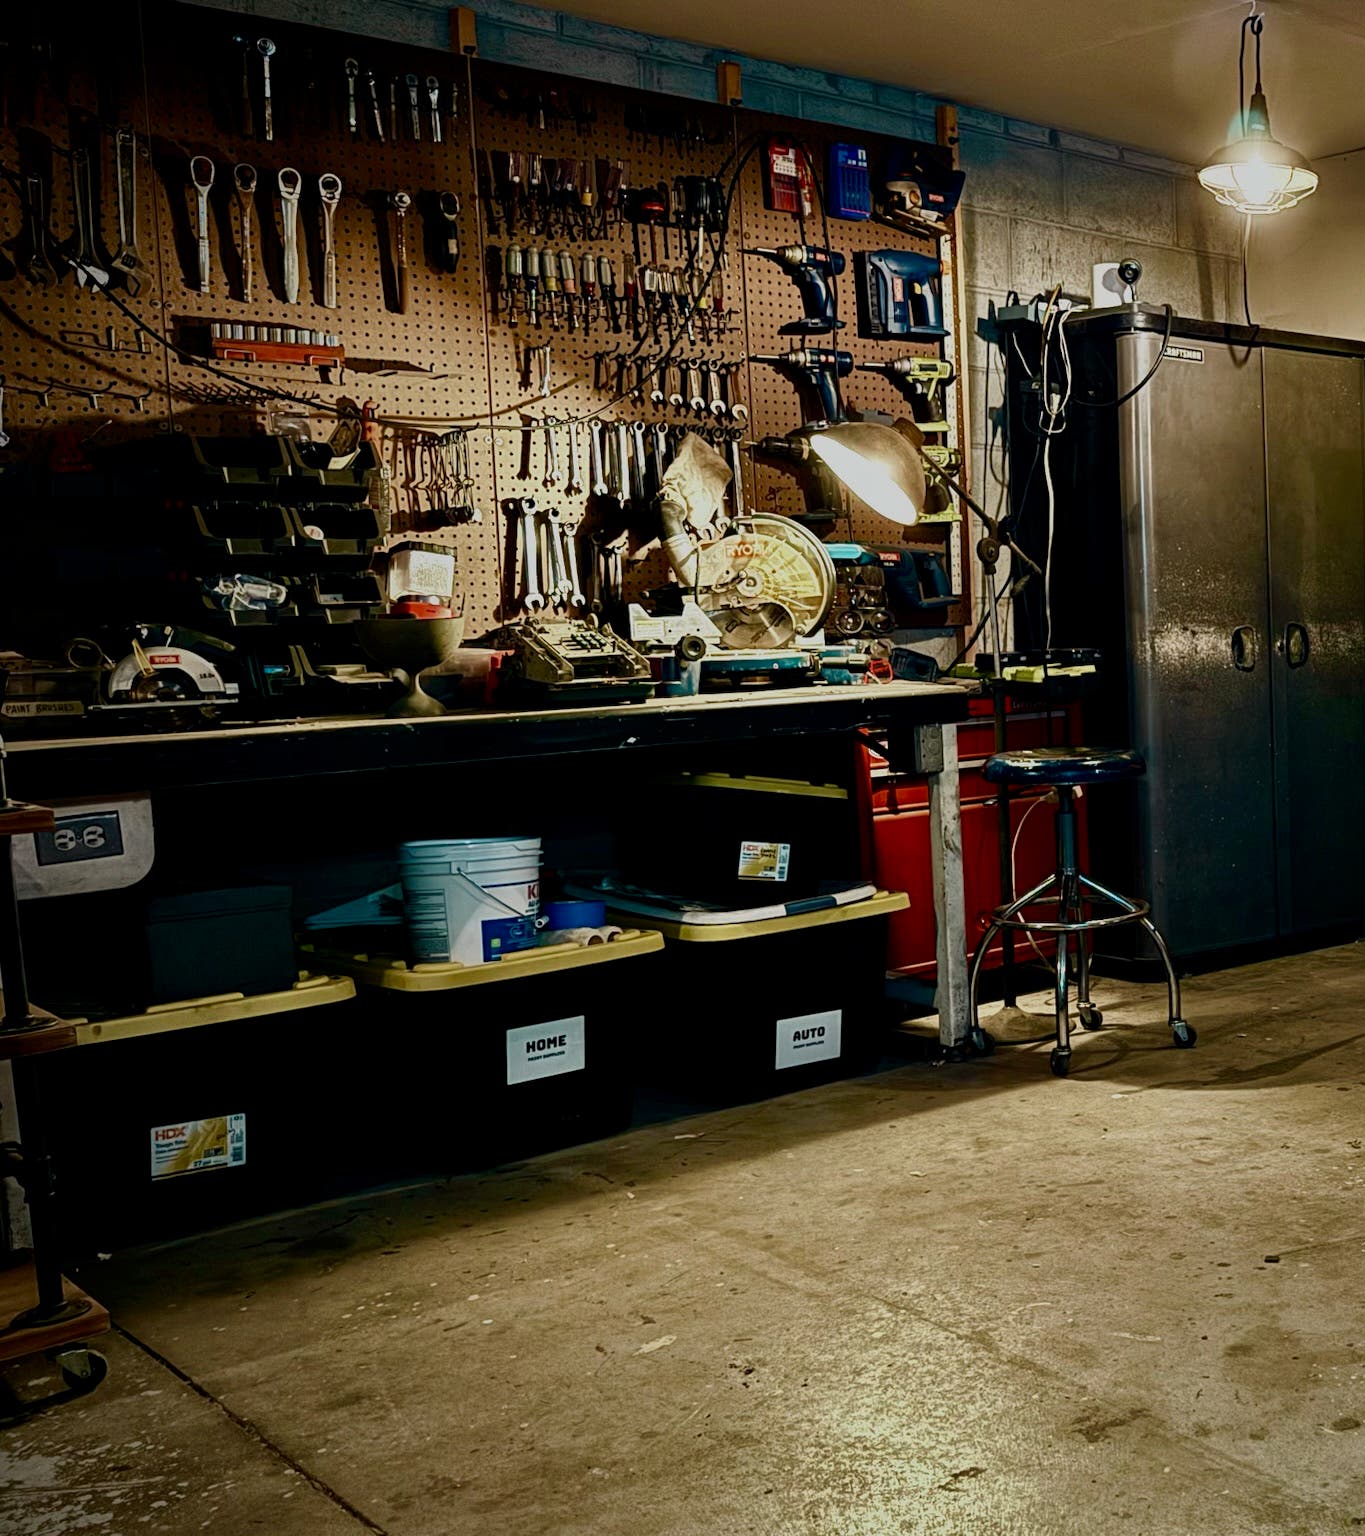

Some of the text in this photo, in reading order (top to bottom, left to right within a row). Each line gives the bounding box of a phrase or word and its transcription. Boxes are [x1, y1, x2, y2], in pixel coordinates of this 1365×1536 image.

[6, 703, 75, 714] PAINT BRUSHES
[793, 1026, 825, 1042] AUTO
[526, 1034, 567, 1054] HOME
[155, 1126, 187, 1142] HDX
